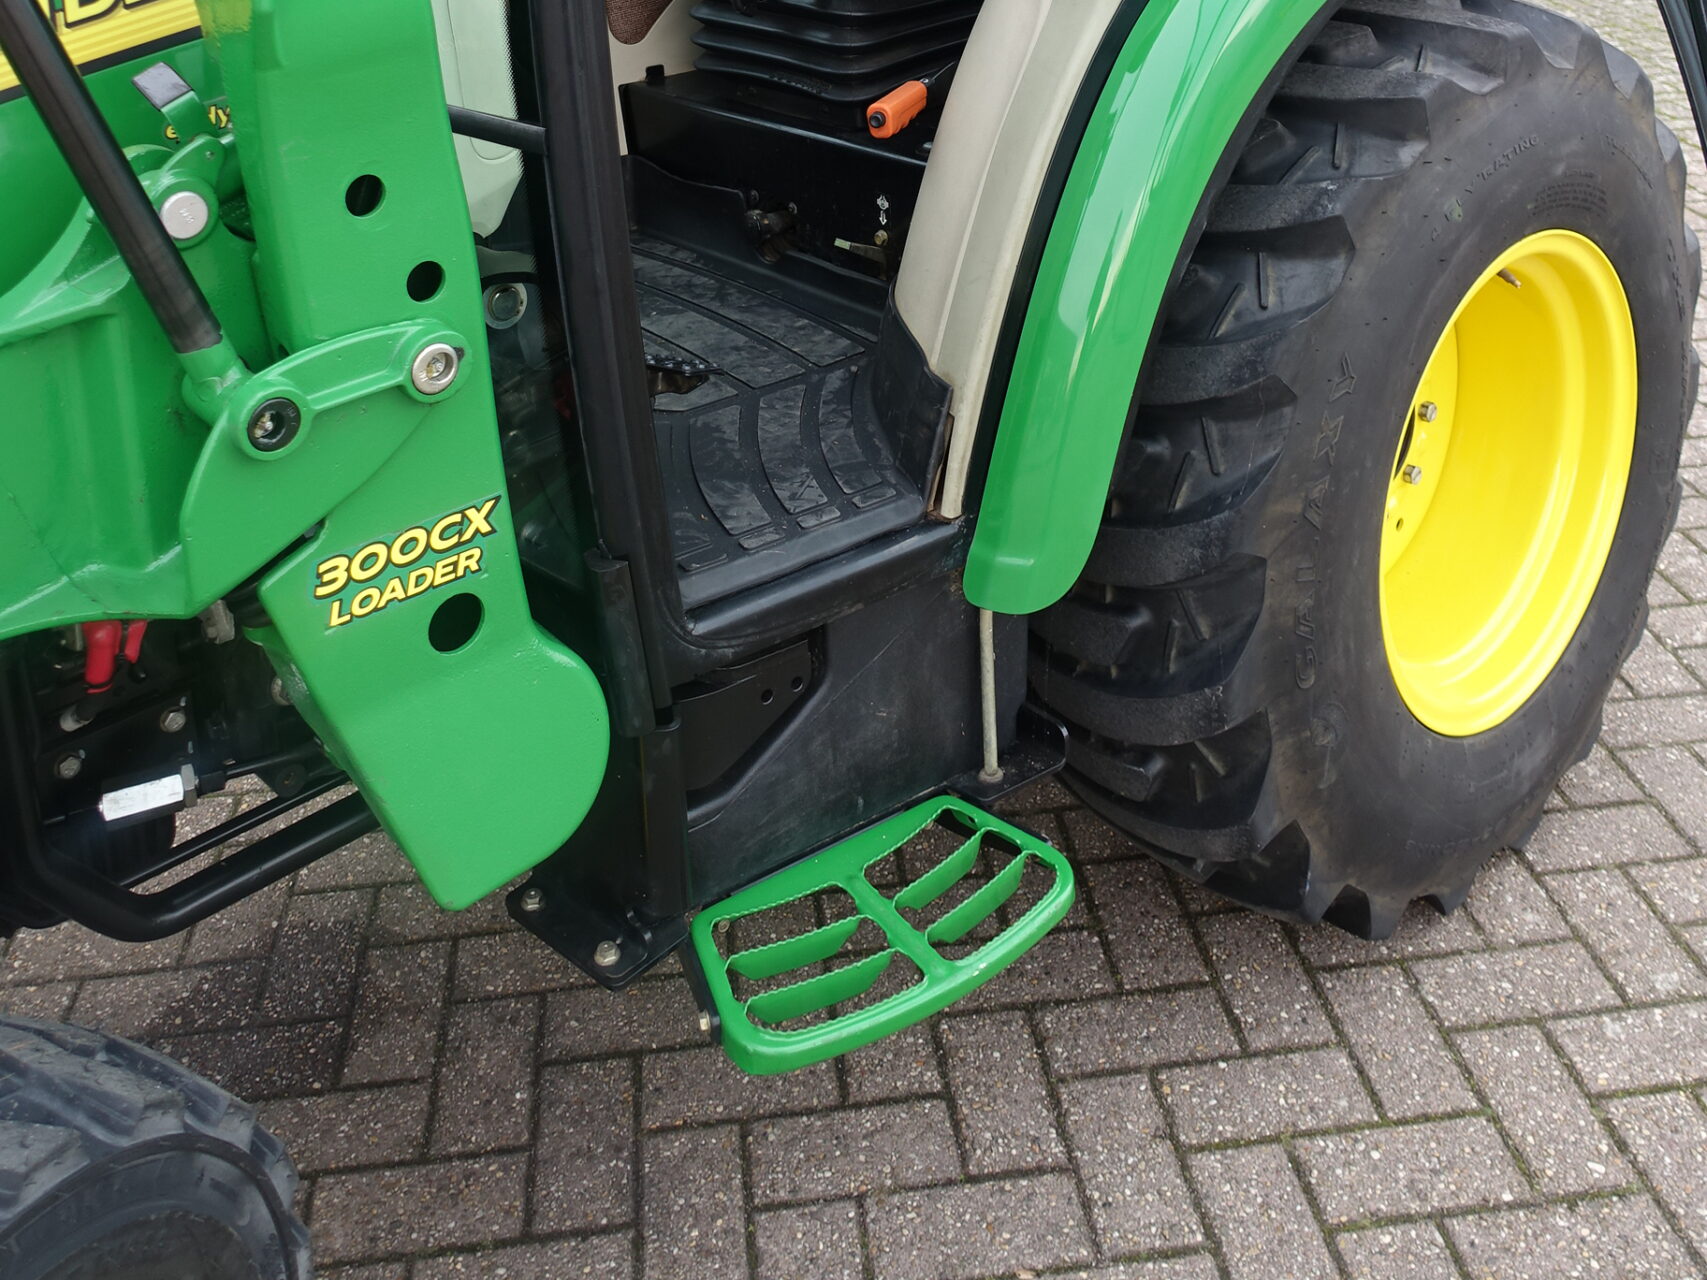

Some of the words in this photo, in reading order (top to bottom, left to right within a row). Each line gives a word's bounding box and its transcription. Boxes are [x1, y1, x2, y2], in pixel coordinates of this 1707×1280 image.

[314, 495, 501, 599] 300CX
[1295, 352, 1357, 689] GALAXY
[328, 547, 482, 627] LOADER
